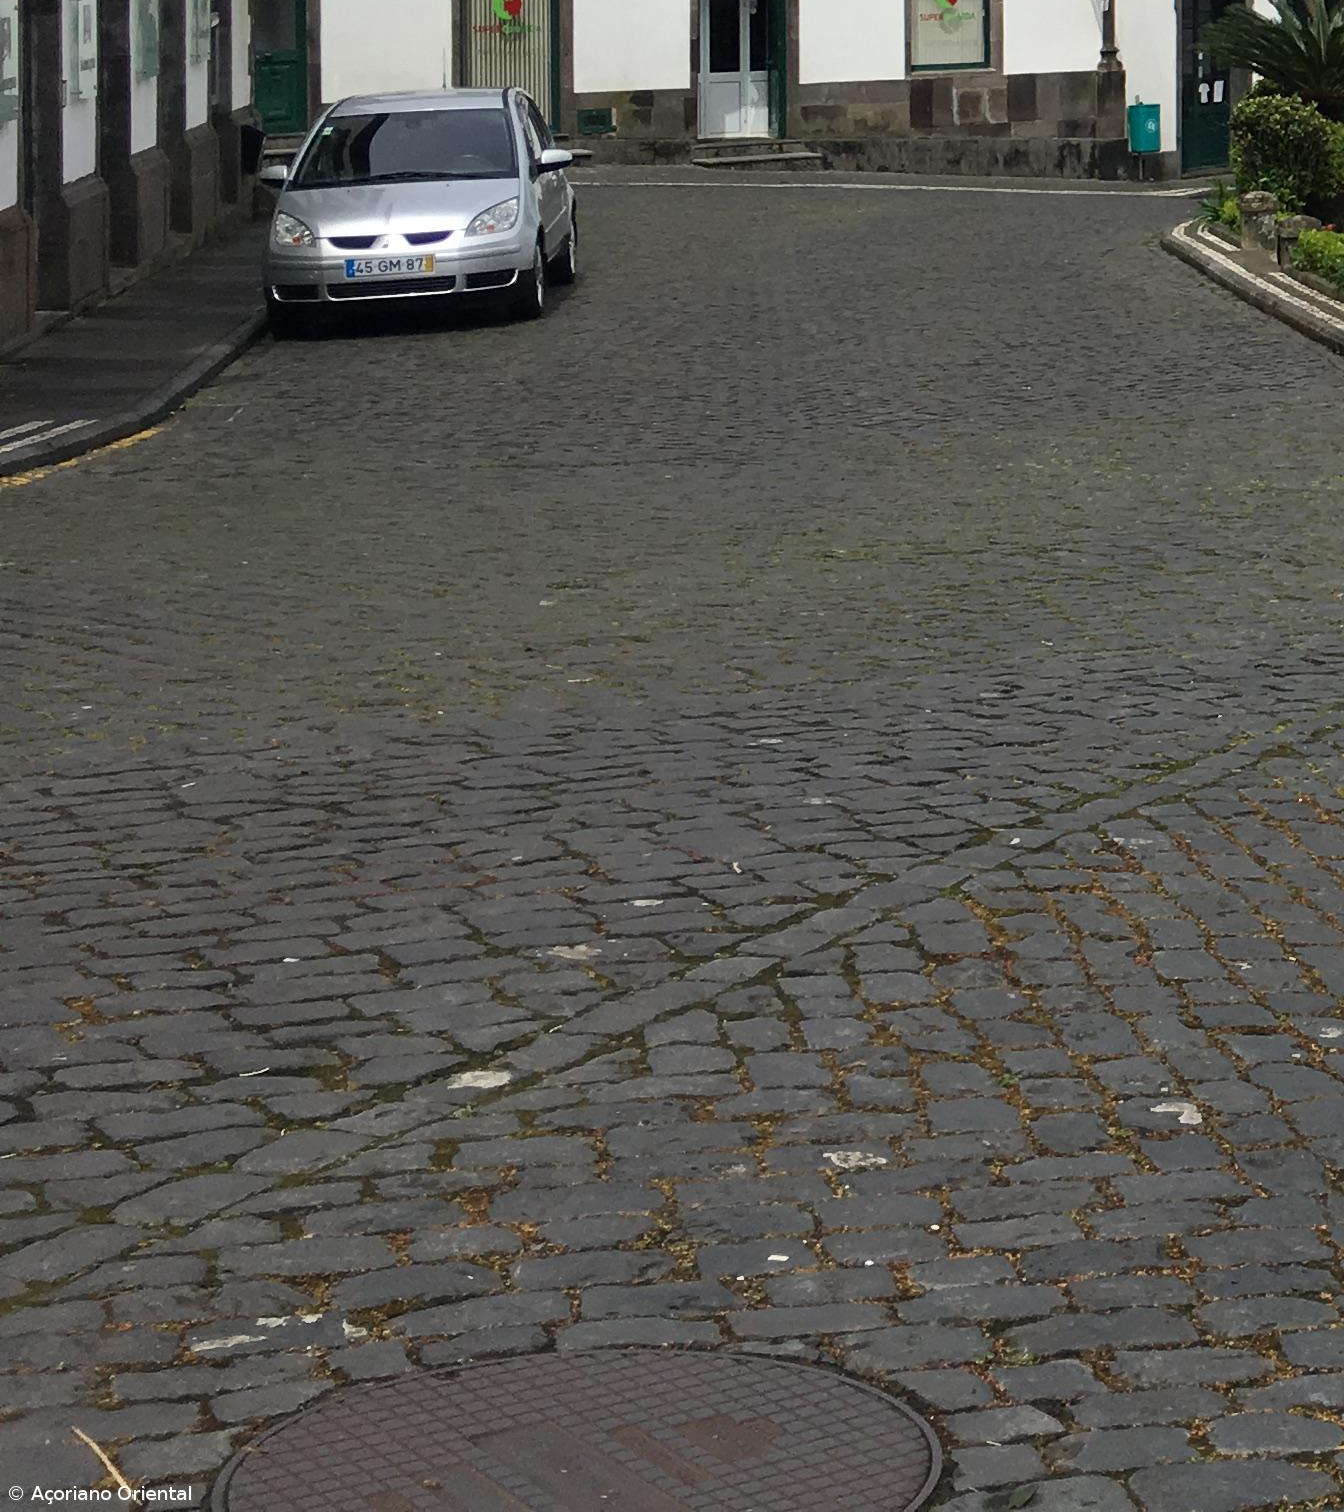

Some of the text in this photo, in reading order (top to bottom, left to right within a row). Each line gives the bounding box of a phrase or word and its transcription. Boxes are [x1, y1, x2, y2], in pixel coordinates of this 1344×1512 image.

[355, 257, 424, 274] 45 GM 87
